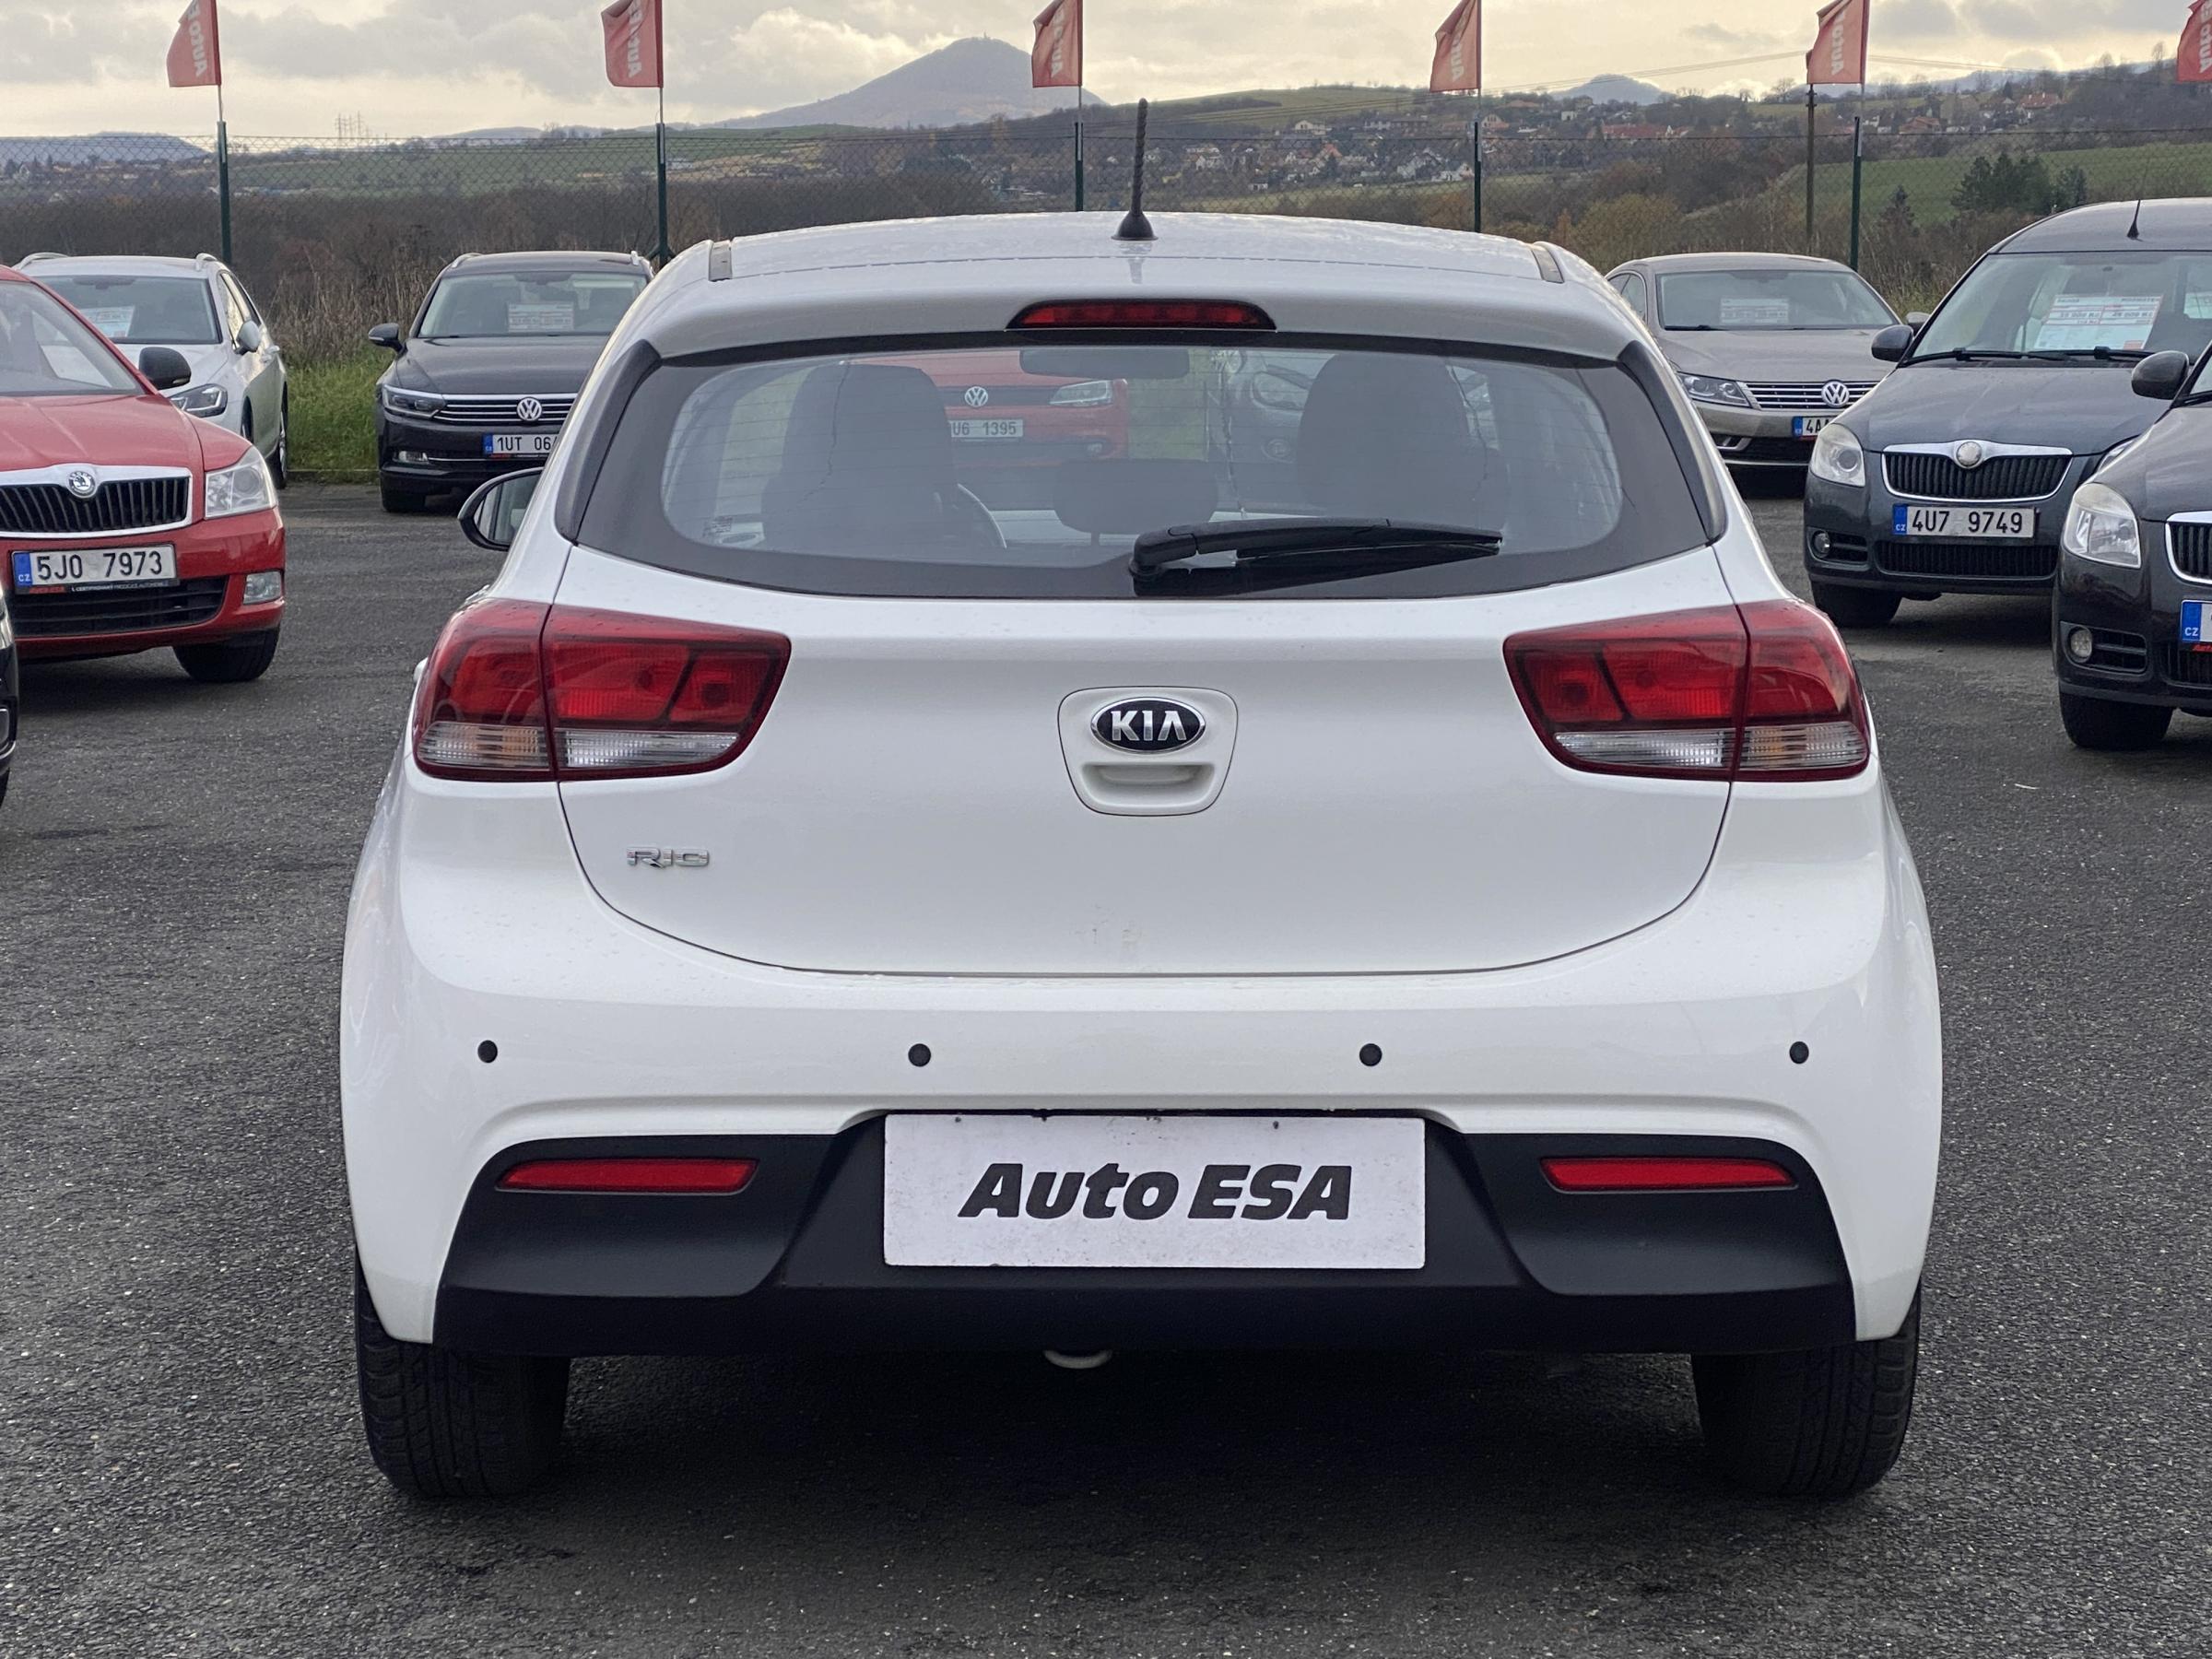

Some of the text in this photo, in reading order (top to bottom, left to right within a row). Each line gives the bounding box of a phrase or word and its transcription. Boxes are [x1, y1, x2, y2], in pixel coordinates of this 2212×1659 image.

[952, 421, 1017, 436] U6 1395
[1806, 418, 1829, 434] 4A
[497, 436, 523, 452] 1UT
[535, 436, 557, 451] 06
[1912, 509, 1950, 533] 4U7
[1968, 511, 2023, 535] 9749
[18, 550, 163, 582] CZ 5J0 7973
[2184, 627, 2199, 637] CZ
[1110, 710, 1187, 741] KIA
[626, 846, 710, 869] RIO
[957, 1162, 1353, 1221] Auto ESA
